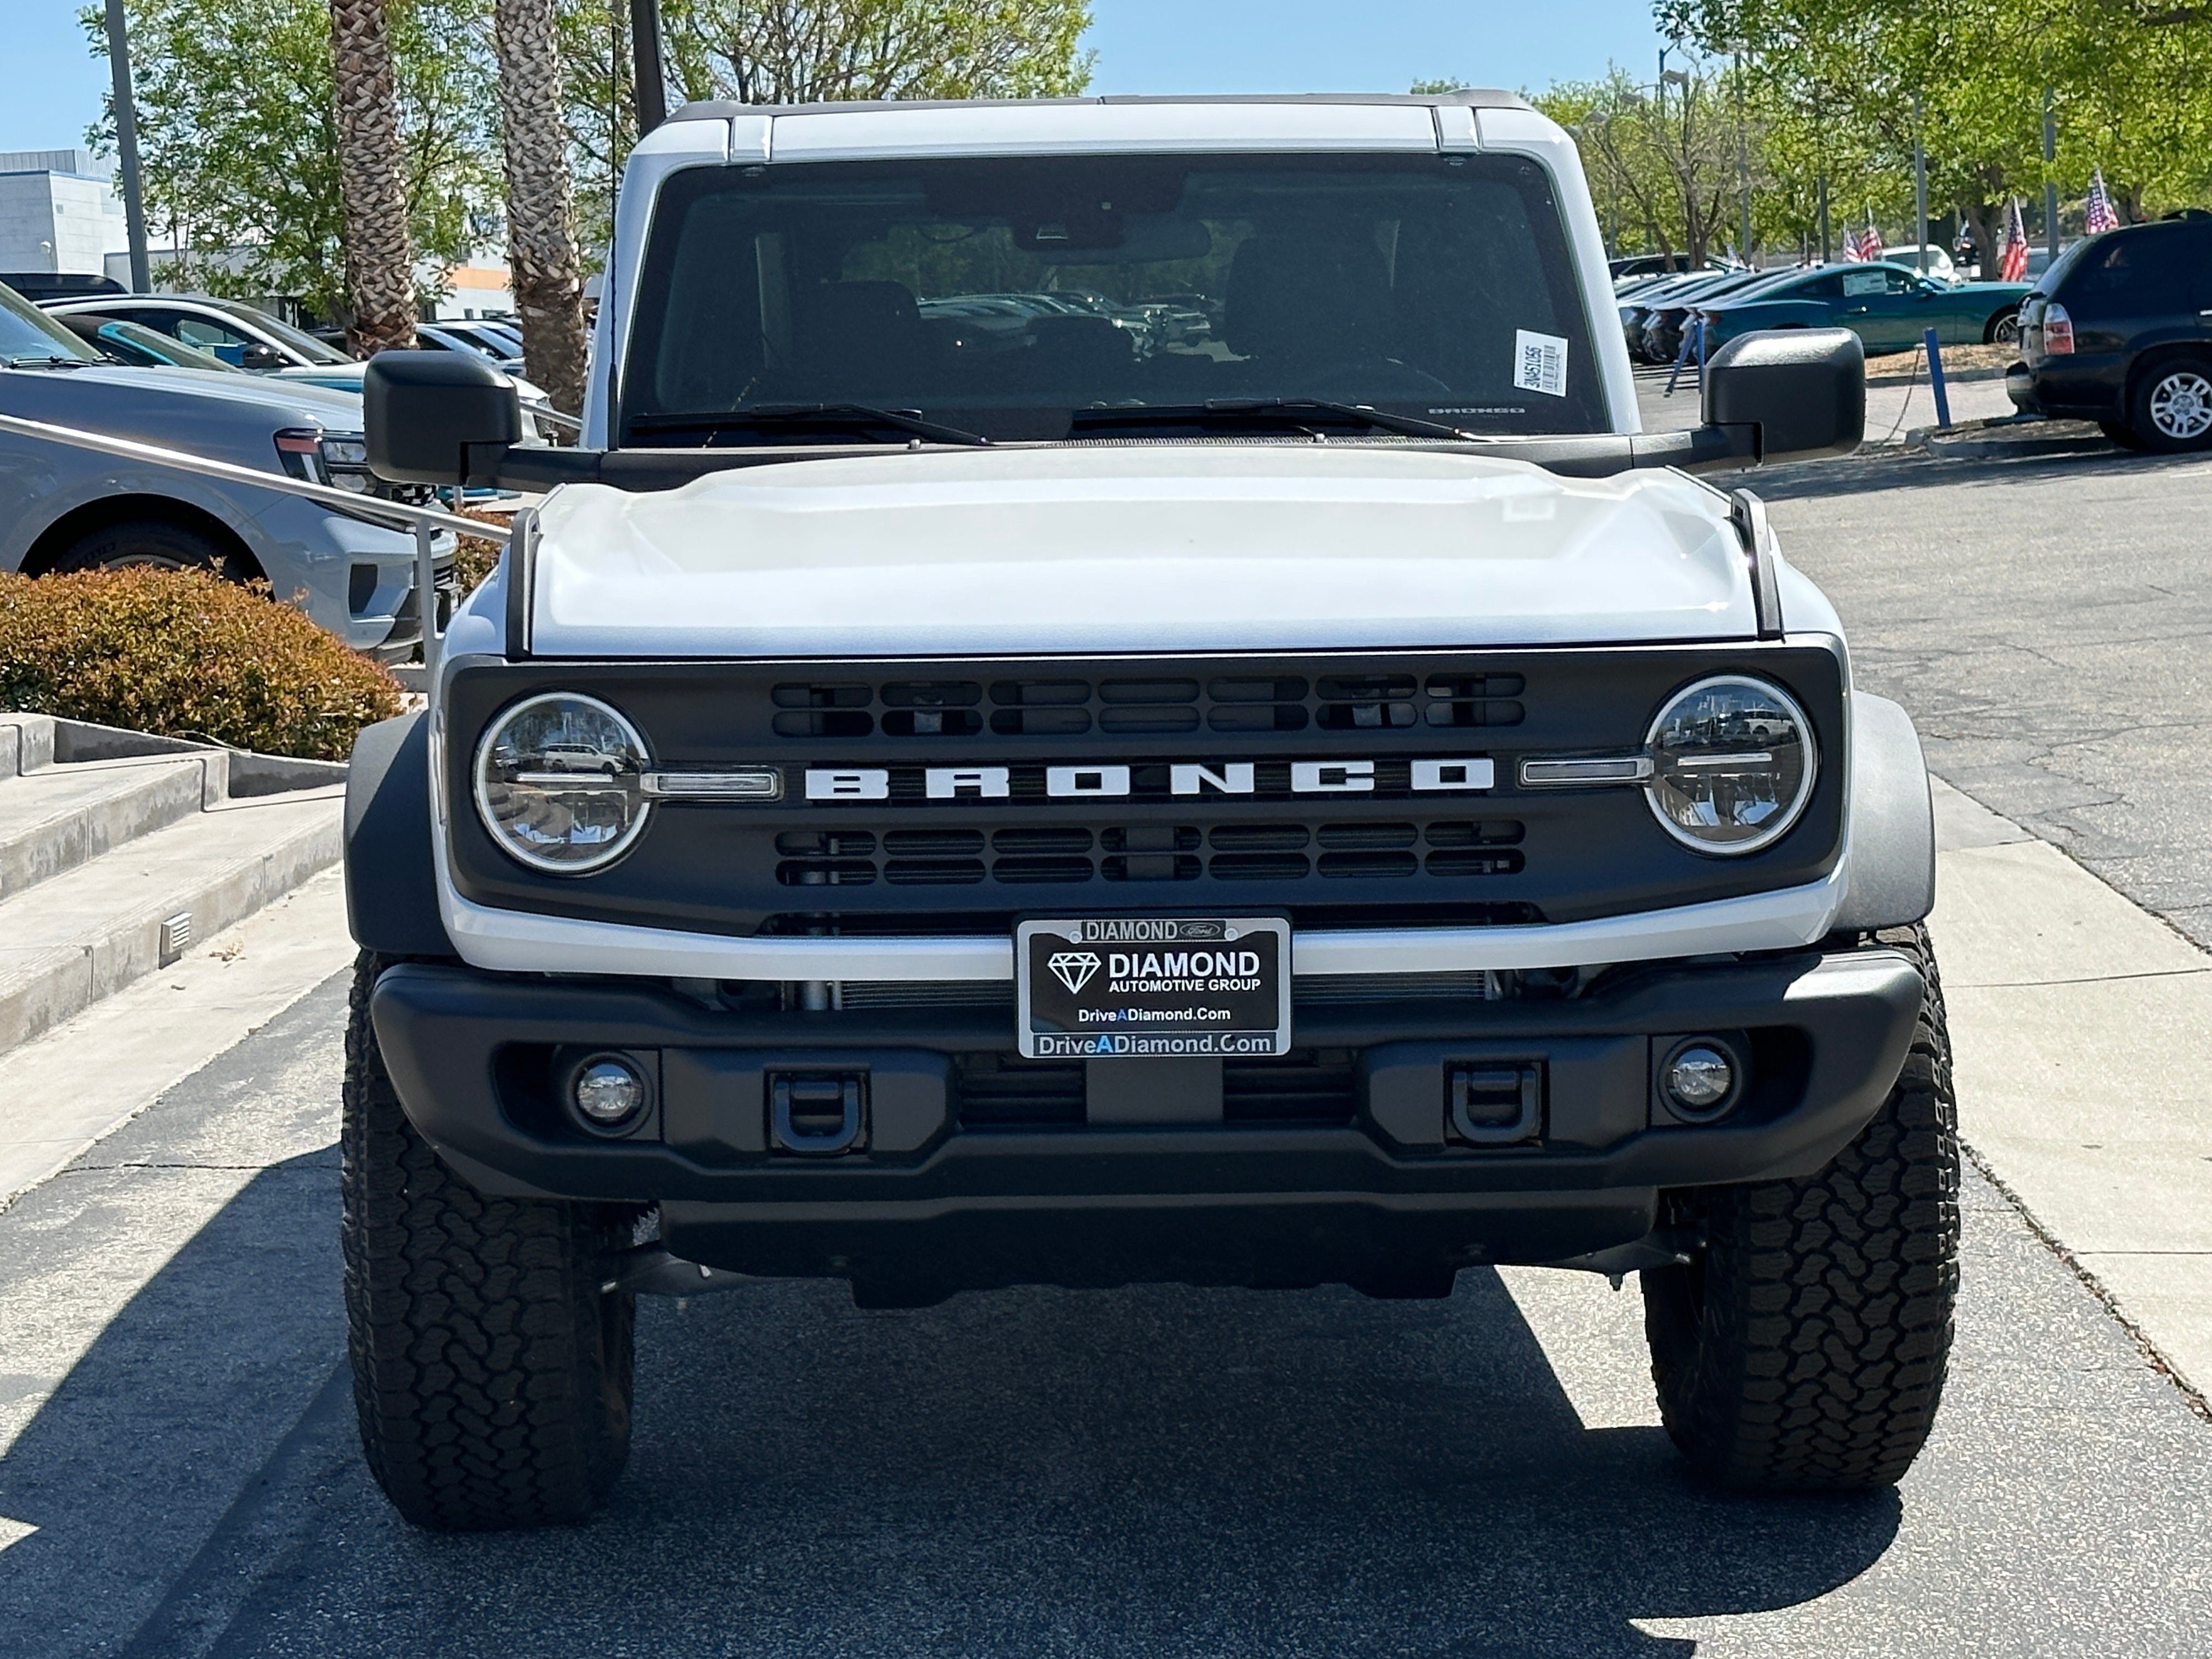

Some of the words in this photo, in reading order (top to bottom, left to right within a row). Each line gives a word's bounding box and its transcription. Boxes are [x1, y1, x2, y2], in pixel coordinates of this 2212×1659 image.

[805, 758, 1494, 799] BRONCO
[1086, 921, 1178, 940] DIAMOND
[1109, 951, 1260, 978] DIAMOND
[1109, 980, 1204, 993] AUTOMOTIVE
[1209, 979, 1261, 991] GROUP
[1079, 1007, 1231, 1022] DriveADiamond.Com
[1039, 1035, 1272, 1055] DriveADiamond.Com
